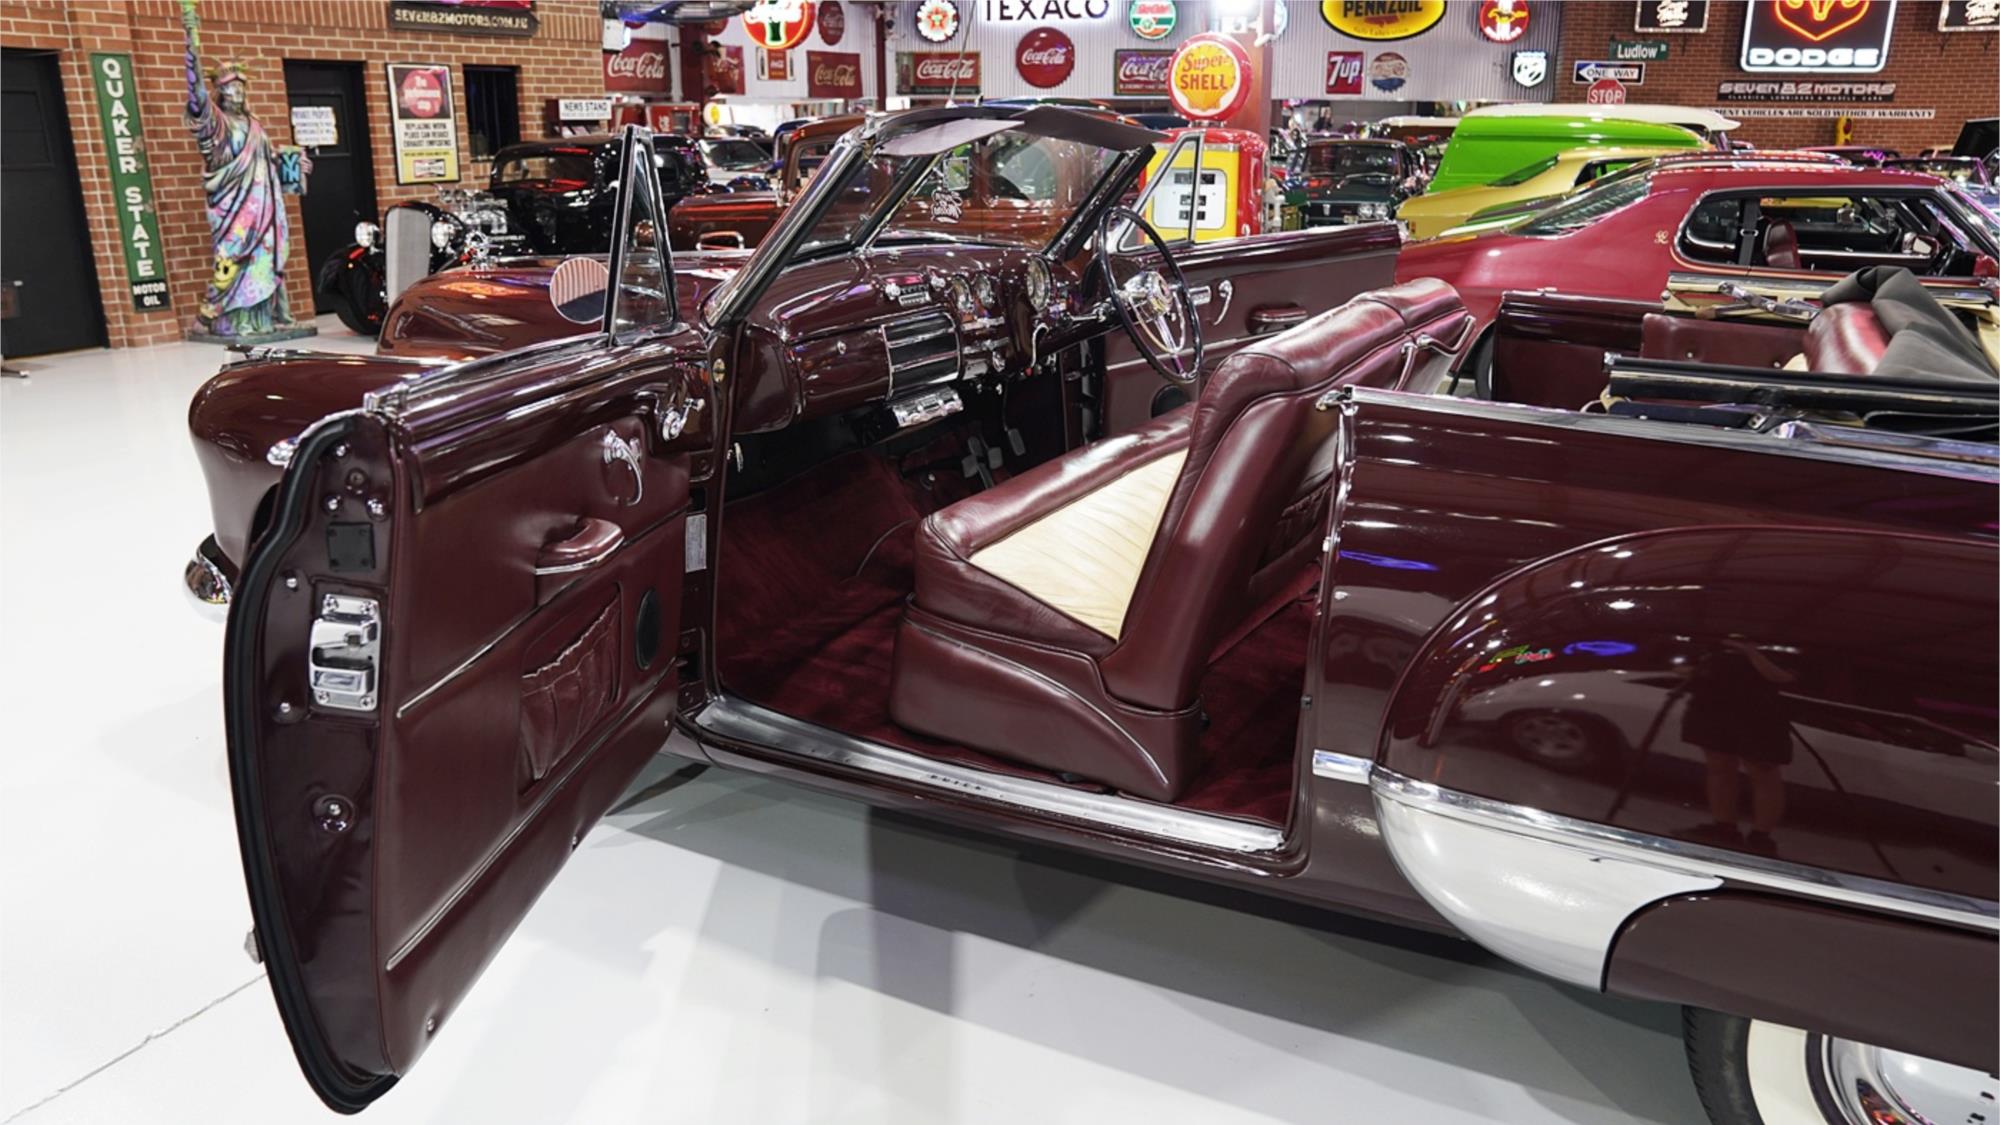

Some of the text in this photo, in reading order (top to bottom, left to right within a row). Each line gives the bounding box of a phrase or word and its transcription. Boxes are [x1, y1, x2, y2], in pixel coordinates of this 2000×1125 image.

[1021, 47, 1067, 65] Coca-Cola
[1617, 43, 1658, 58] Ludlow
[1749, 48, 1880, 67] DODGE
[607, 52, 664, 79] Coca-Cola
[916, 59, 976, 79] Coca-Cola
[1182, 52, 1230, 72] Super
[814, 63, 856, 86] Coca-Cola
[1586, 67, 1637, 77] ONE WAY
[1180, 73, 1228, 91] SHELL
[1719, 82, 1897, 95] SEVEN 82 MOTORS
[1590, 89, 1623, 104] STOP
[564, 102, 607, 112] NEWS STAND
[1741, 109, 1785, 117] VEHICLES
[1787, 109, 1804, 117] ARE
[1806, 110, 1831, 118] SOLD
[1877, 110, 1933, 118] WARRANTY
[102, 58, 155, 277] QUAKER STATE
[132, 282, 167, 296] MOTOR
[142, 294, 161, 306] OIL
